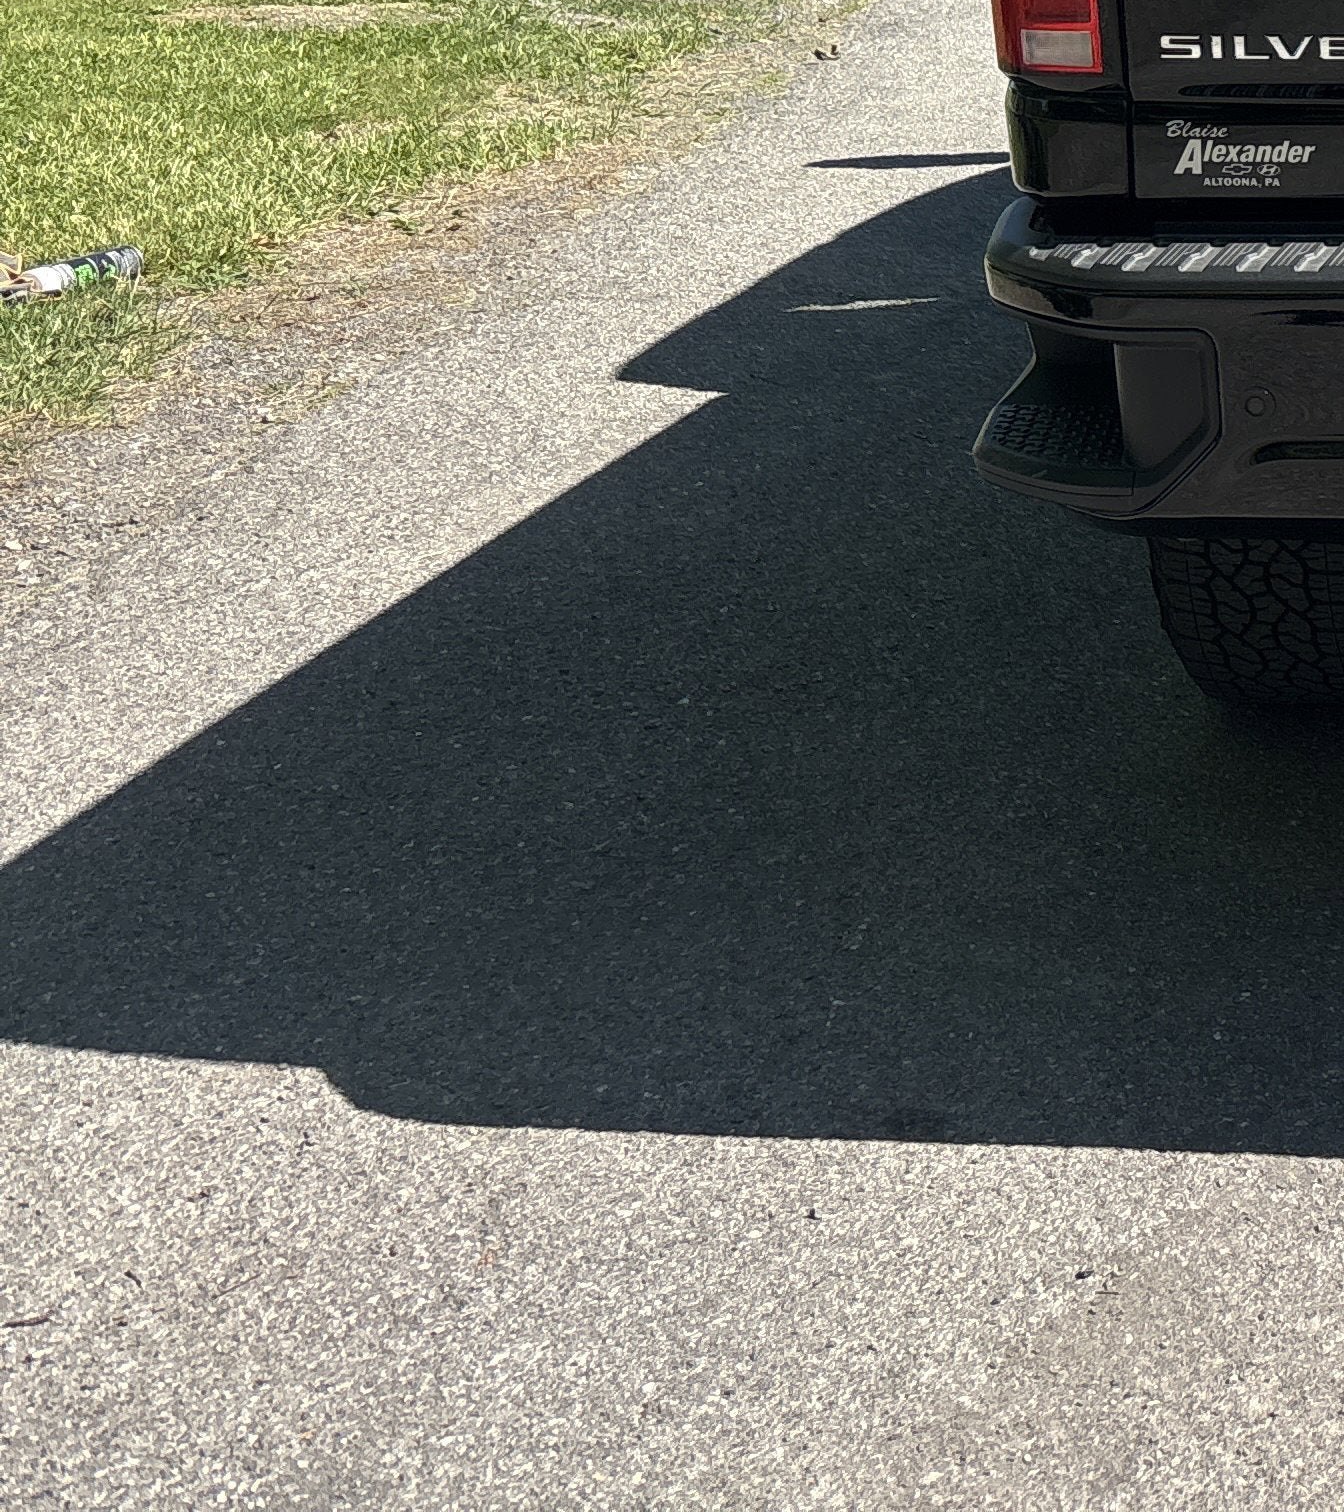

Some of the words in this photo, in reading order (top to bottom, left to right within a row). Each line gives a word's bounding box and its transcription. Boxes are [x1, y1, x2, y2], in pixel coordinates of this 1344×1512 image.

[1165, 120, 1229, 138] Blaise
[1173, 139, 1317, 175] Alexander
[1203, 177, 1262, 188] ALTOONA,
[1264, 177, 1281, 187] PA
